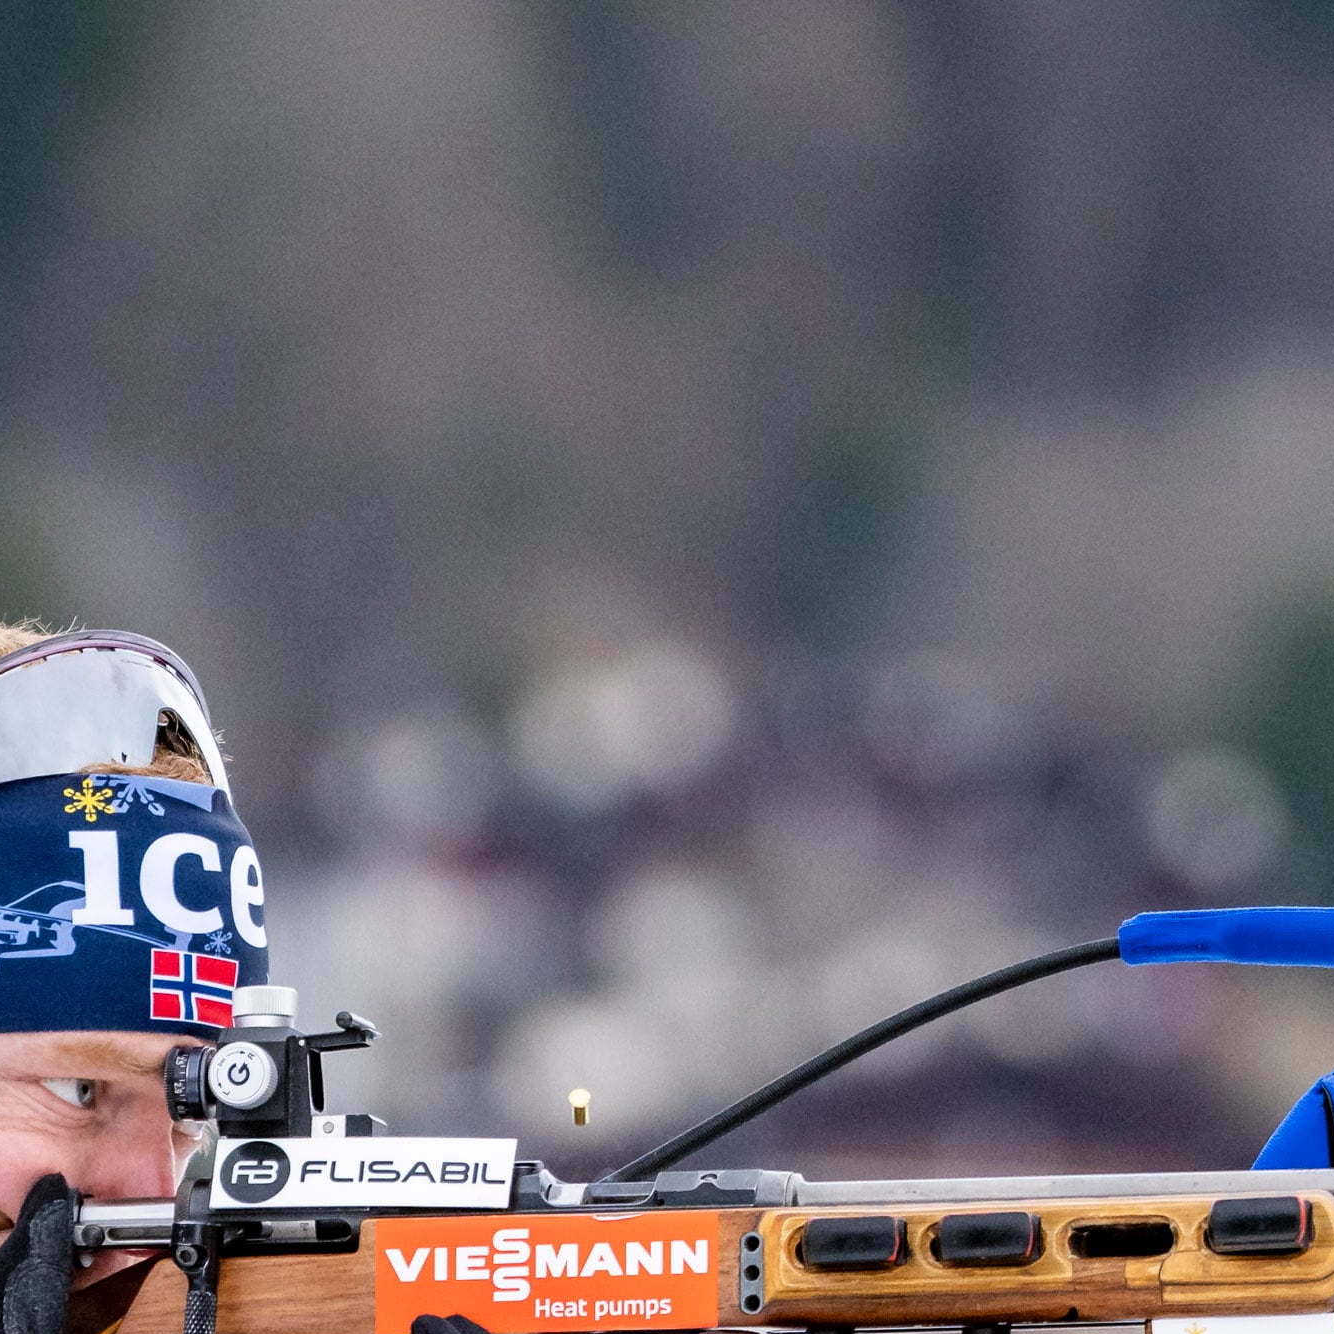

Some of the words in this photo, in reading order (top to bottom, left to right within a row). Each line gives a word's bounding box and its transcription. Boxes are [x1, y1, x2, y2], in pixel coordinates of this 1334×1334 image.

[69, 829, 267, 948] ice
[300, 1160, 506, 1185] FLISABIL
[384, 1228, 709, 1301] VIESSMANN
[535, 1298, 588, 1318] Heat
[595, 1298, 672, 1320] pumps
